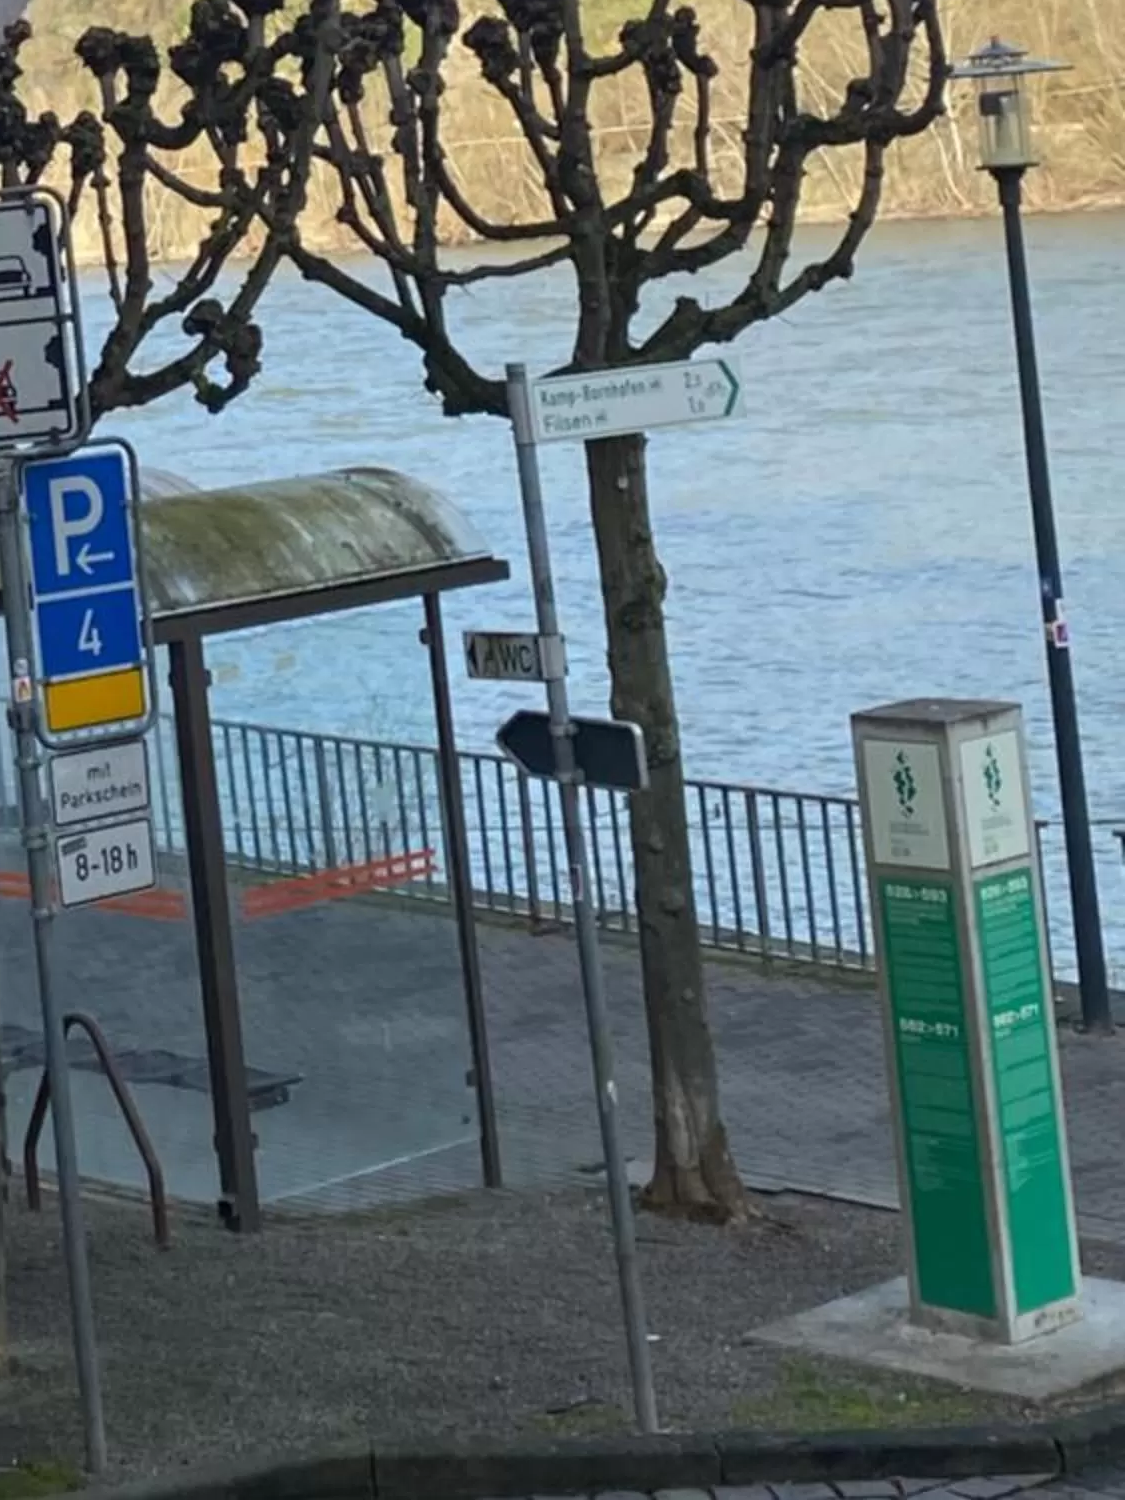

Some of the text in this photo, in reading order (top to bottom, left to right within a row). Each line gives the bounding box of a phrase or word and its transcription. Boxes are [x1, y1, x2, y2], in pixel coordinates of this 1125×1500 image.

[49, 475, 104, 575] P
[78, 608, 103, 656] 4
[87, 762, 112, 781] mit
[61, 782, 142, 809] Parkschein
